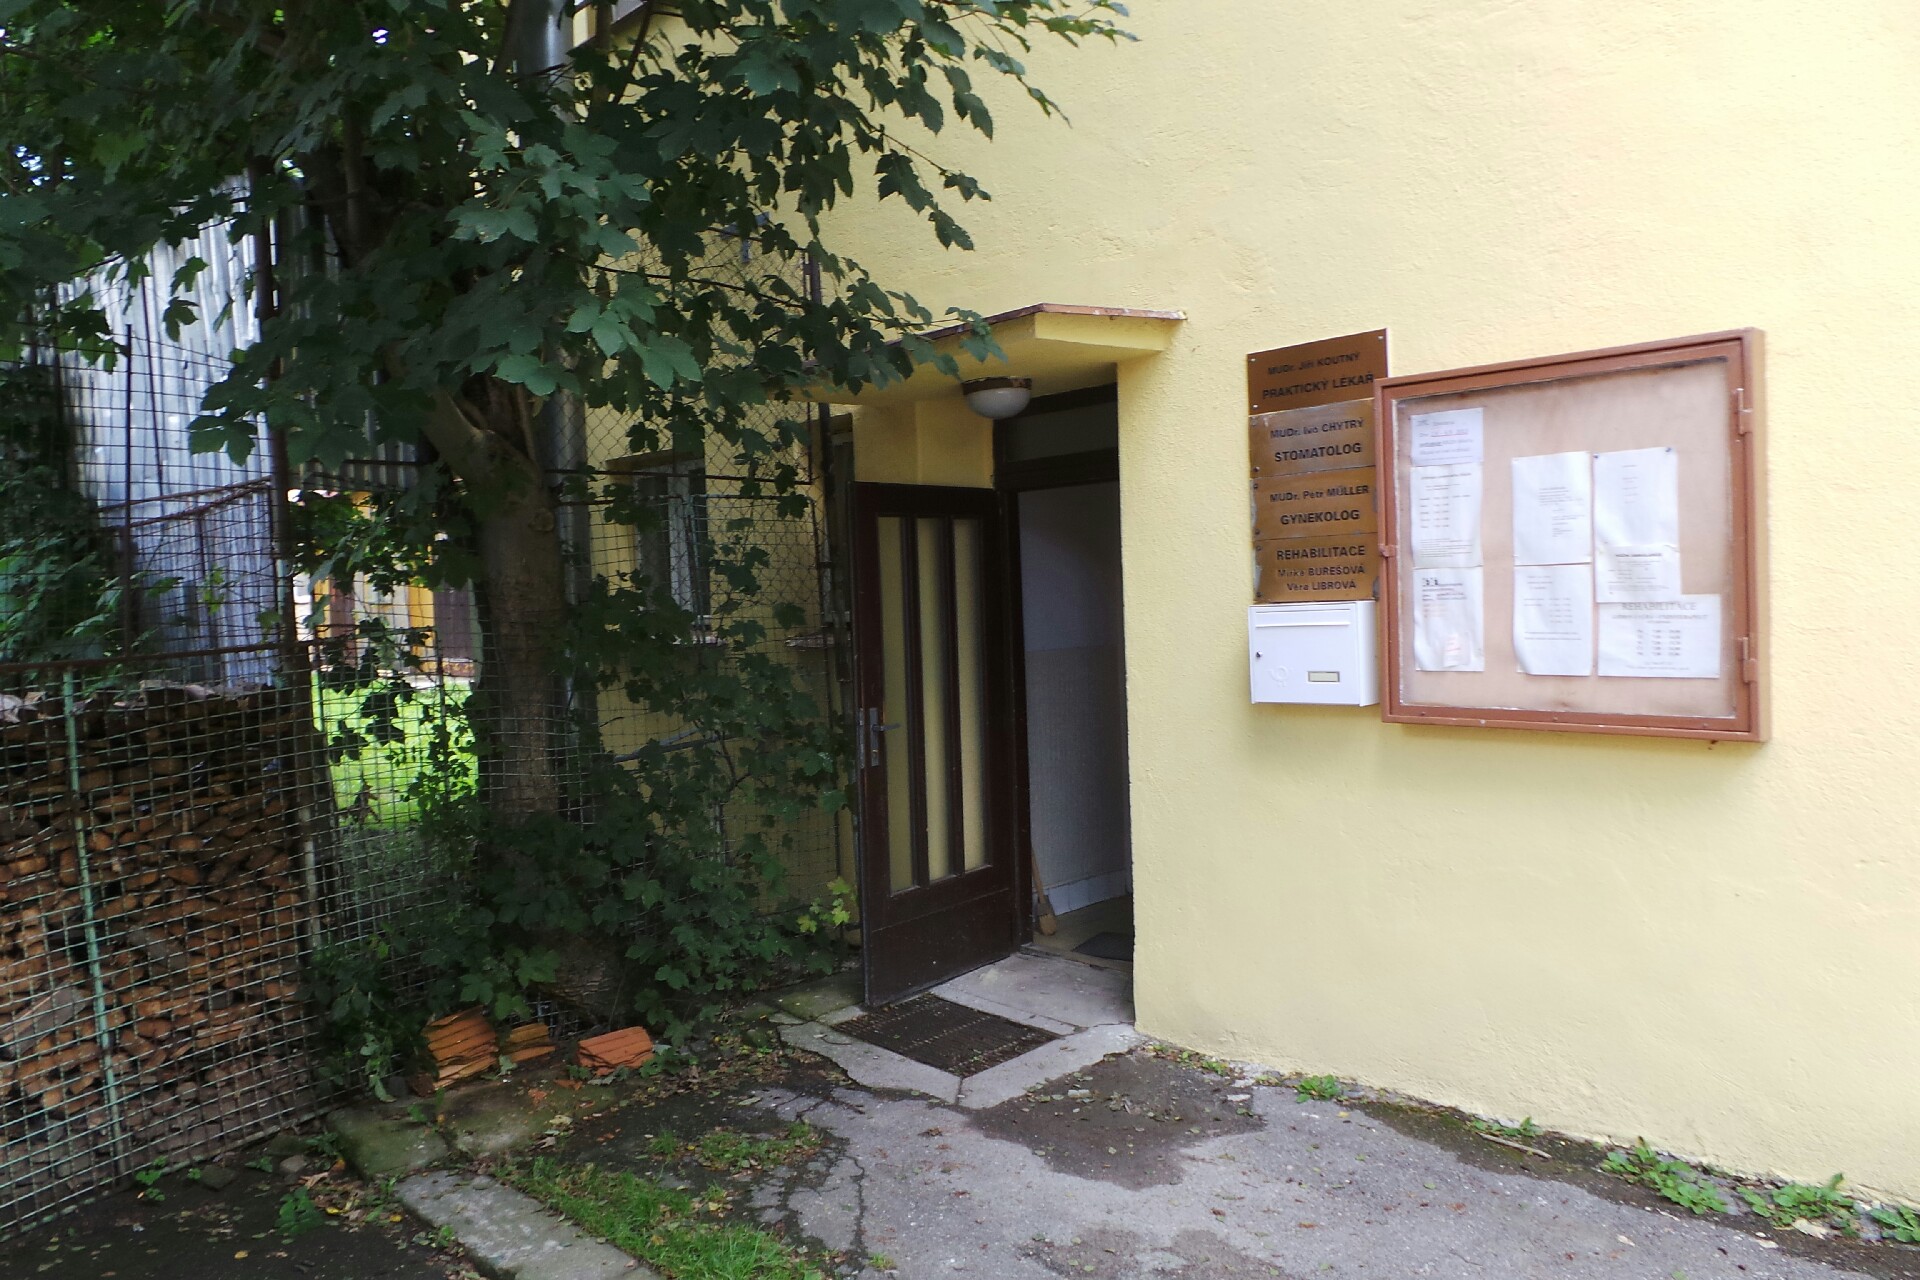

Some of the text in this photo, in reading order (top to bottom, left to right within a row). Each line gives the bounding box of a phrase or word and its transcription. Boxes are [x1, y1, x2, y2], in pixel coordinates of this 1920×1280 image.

[1267, 364, 1294, 375] MUDr.
[1316, 351, 1360, 367] KOUTNÝ
[1262, 371, 1374, 400] PRAKTICKÝ LÉKAŘ
[1270, 417, 1364, 439] MUDr. Ivo CHYTRÝ
[1274, 442, 1362, 462] STOMATOLOG
[1270, 485, 1370, 502] MUDr. Petr MÜLLER
[1280, 509, 1360, 525] GYNEKOLOG
[1277, 545, 1366, 561] REHABILITACE
[1312, 579, 1356, 591] LIBROVÁ
